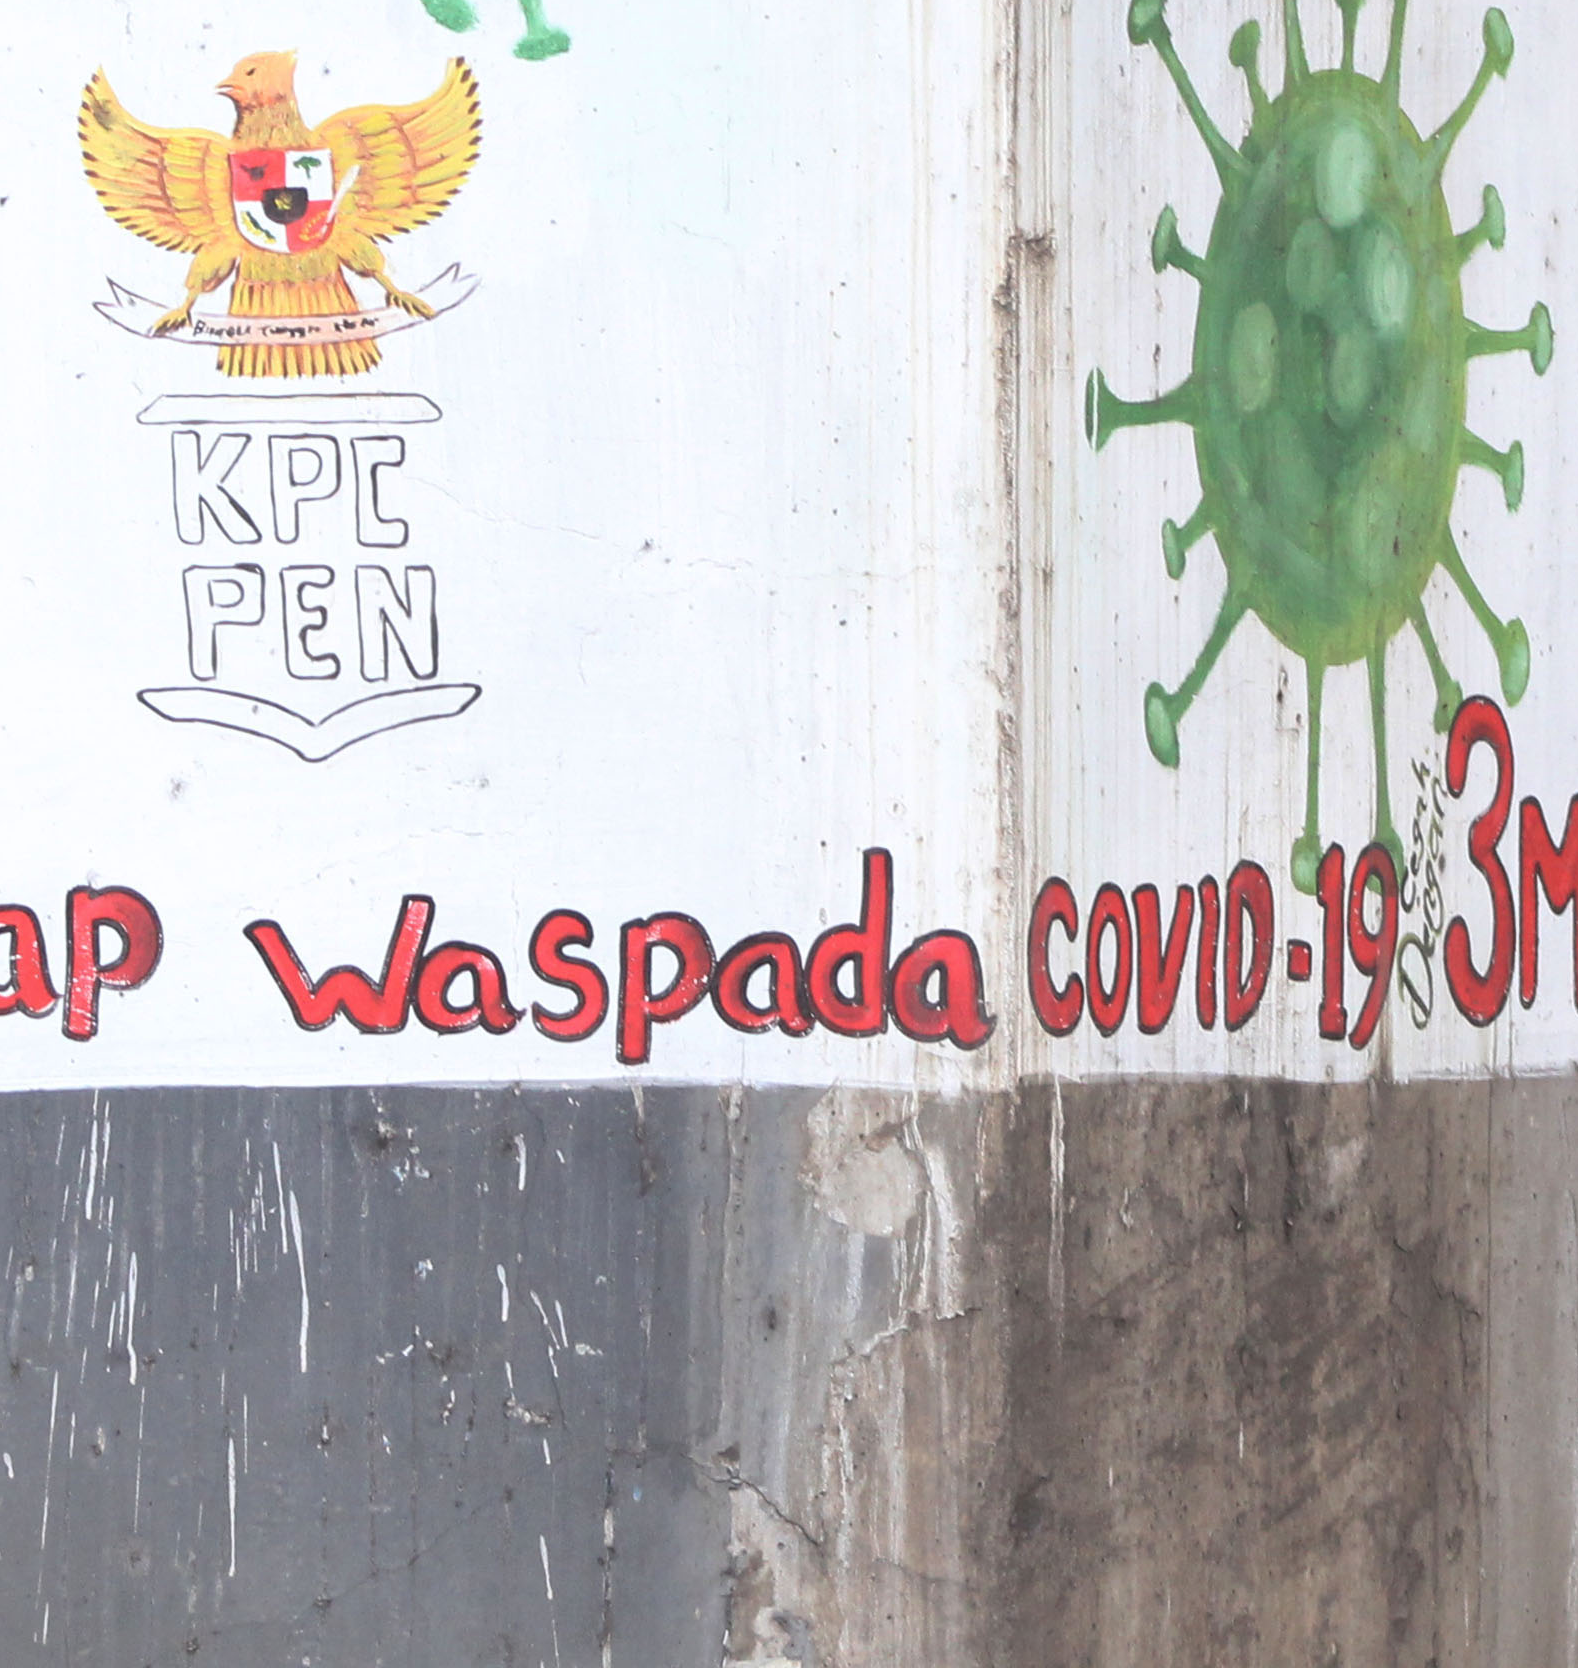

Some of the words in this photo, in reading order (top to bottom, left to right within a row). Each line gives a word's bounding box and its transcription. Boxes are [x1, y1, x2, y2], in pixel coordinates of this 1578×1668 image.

[170, 430, 409, 548] KPC
[182, 562, 439, 682] PEN
[1027, 843, 1400, 1050] COVID-19
